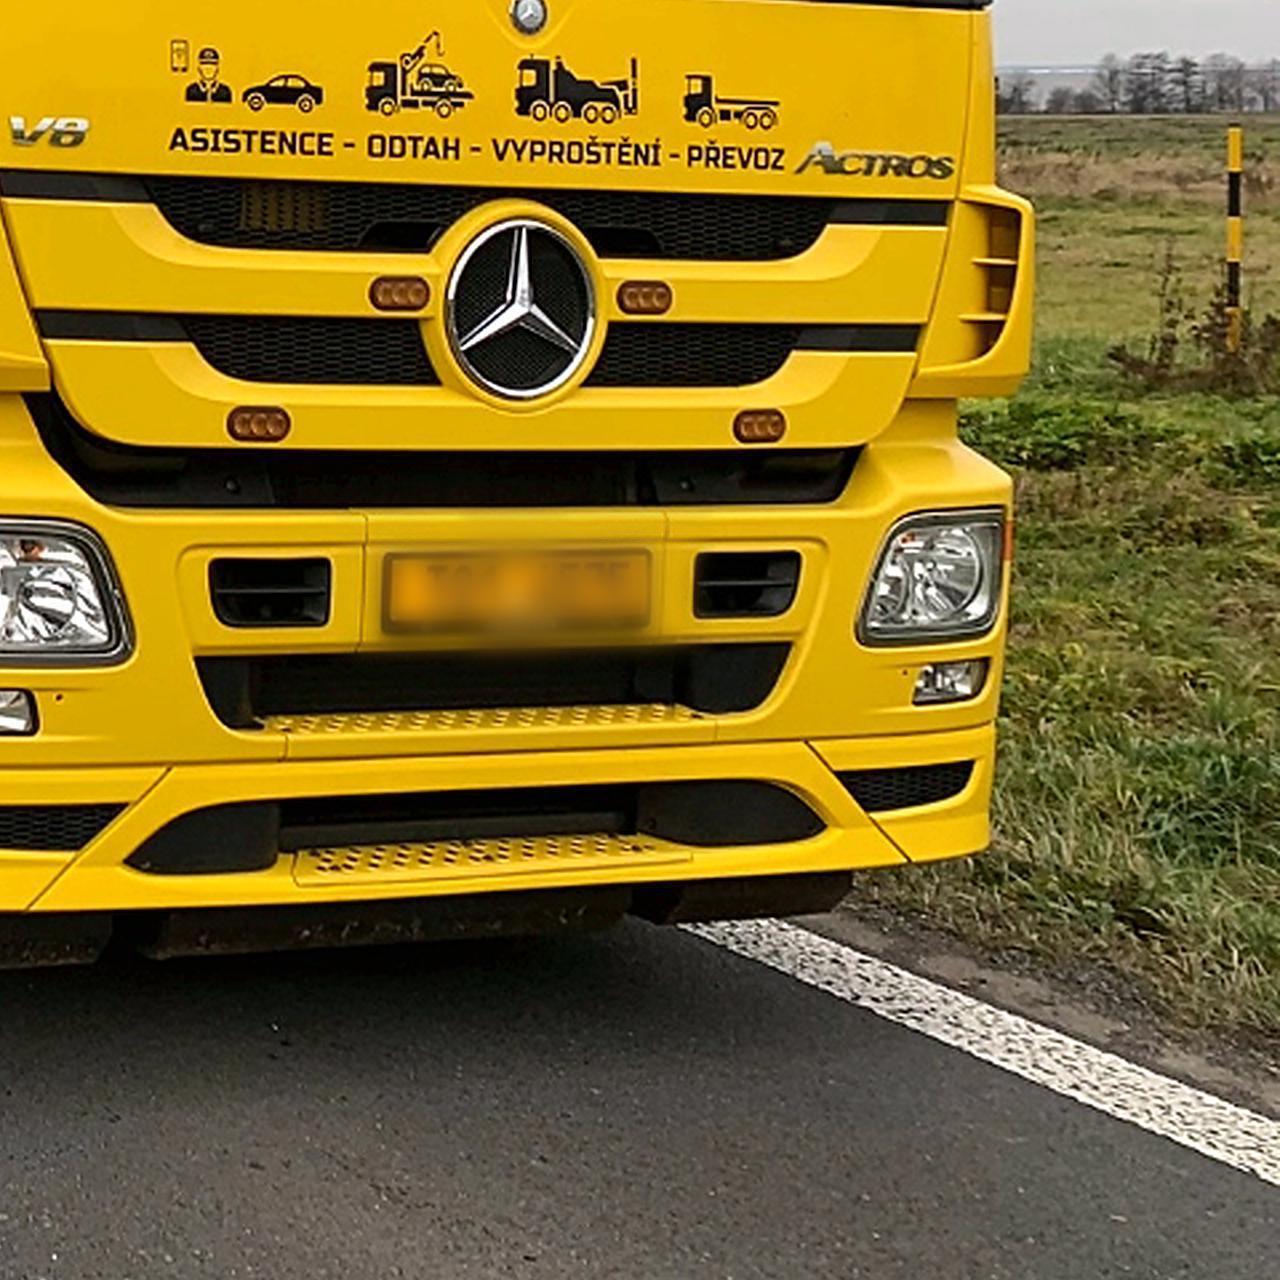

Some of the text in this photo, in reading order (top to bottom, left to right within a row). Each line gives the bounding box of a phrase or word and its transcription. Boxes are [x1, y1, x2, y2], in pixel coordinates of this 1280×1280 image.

[10, 116, 90, 148] V8
[169, 127, 334, 157] ASISTENCE
[366, 134, 461, 161] ODTAH
[491, 136, 662, 168] VYPROŠTĚNÍ
[686, 141, 786, 172] PŘEVOZ
